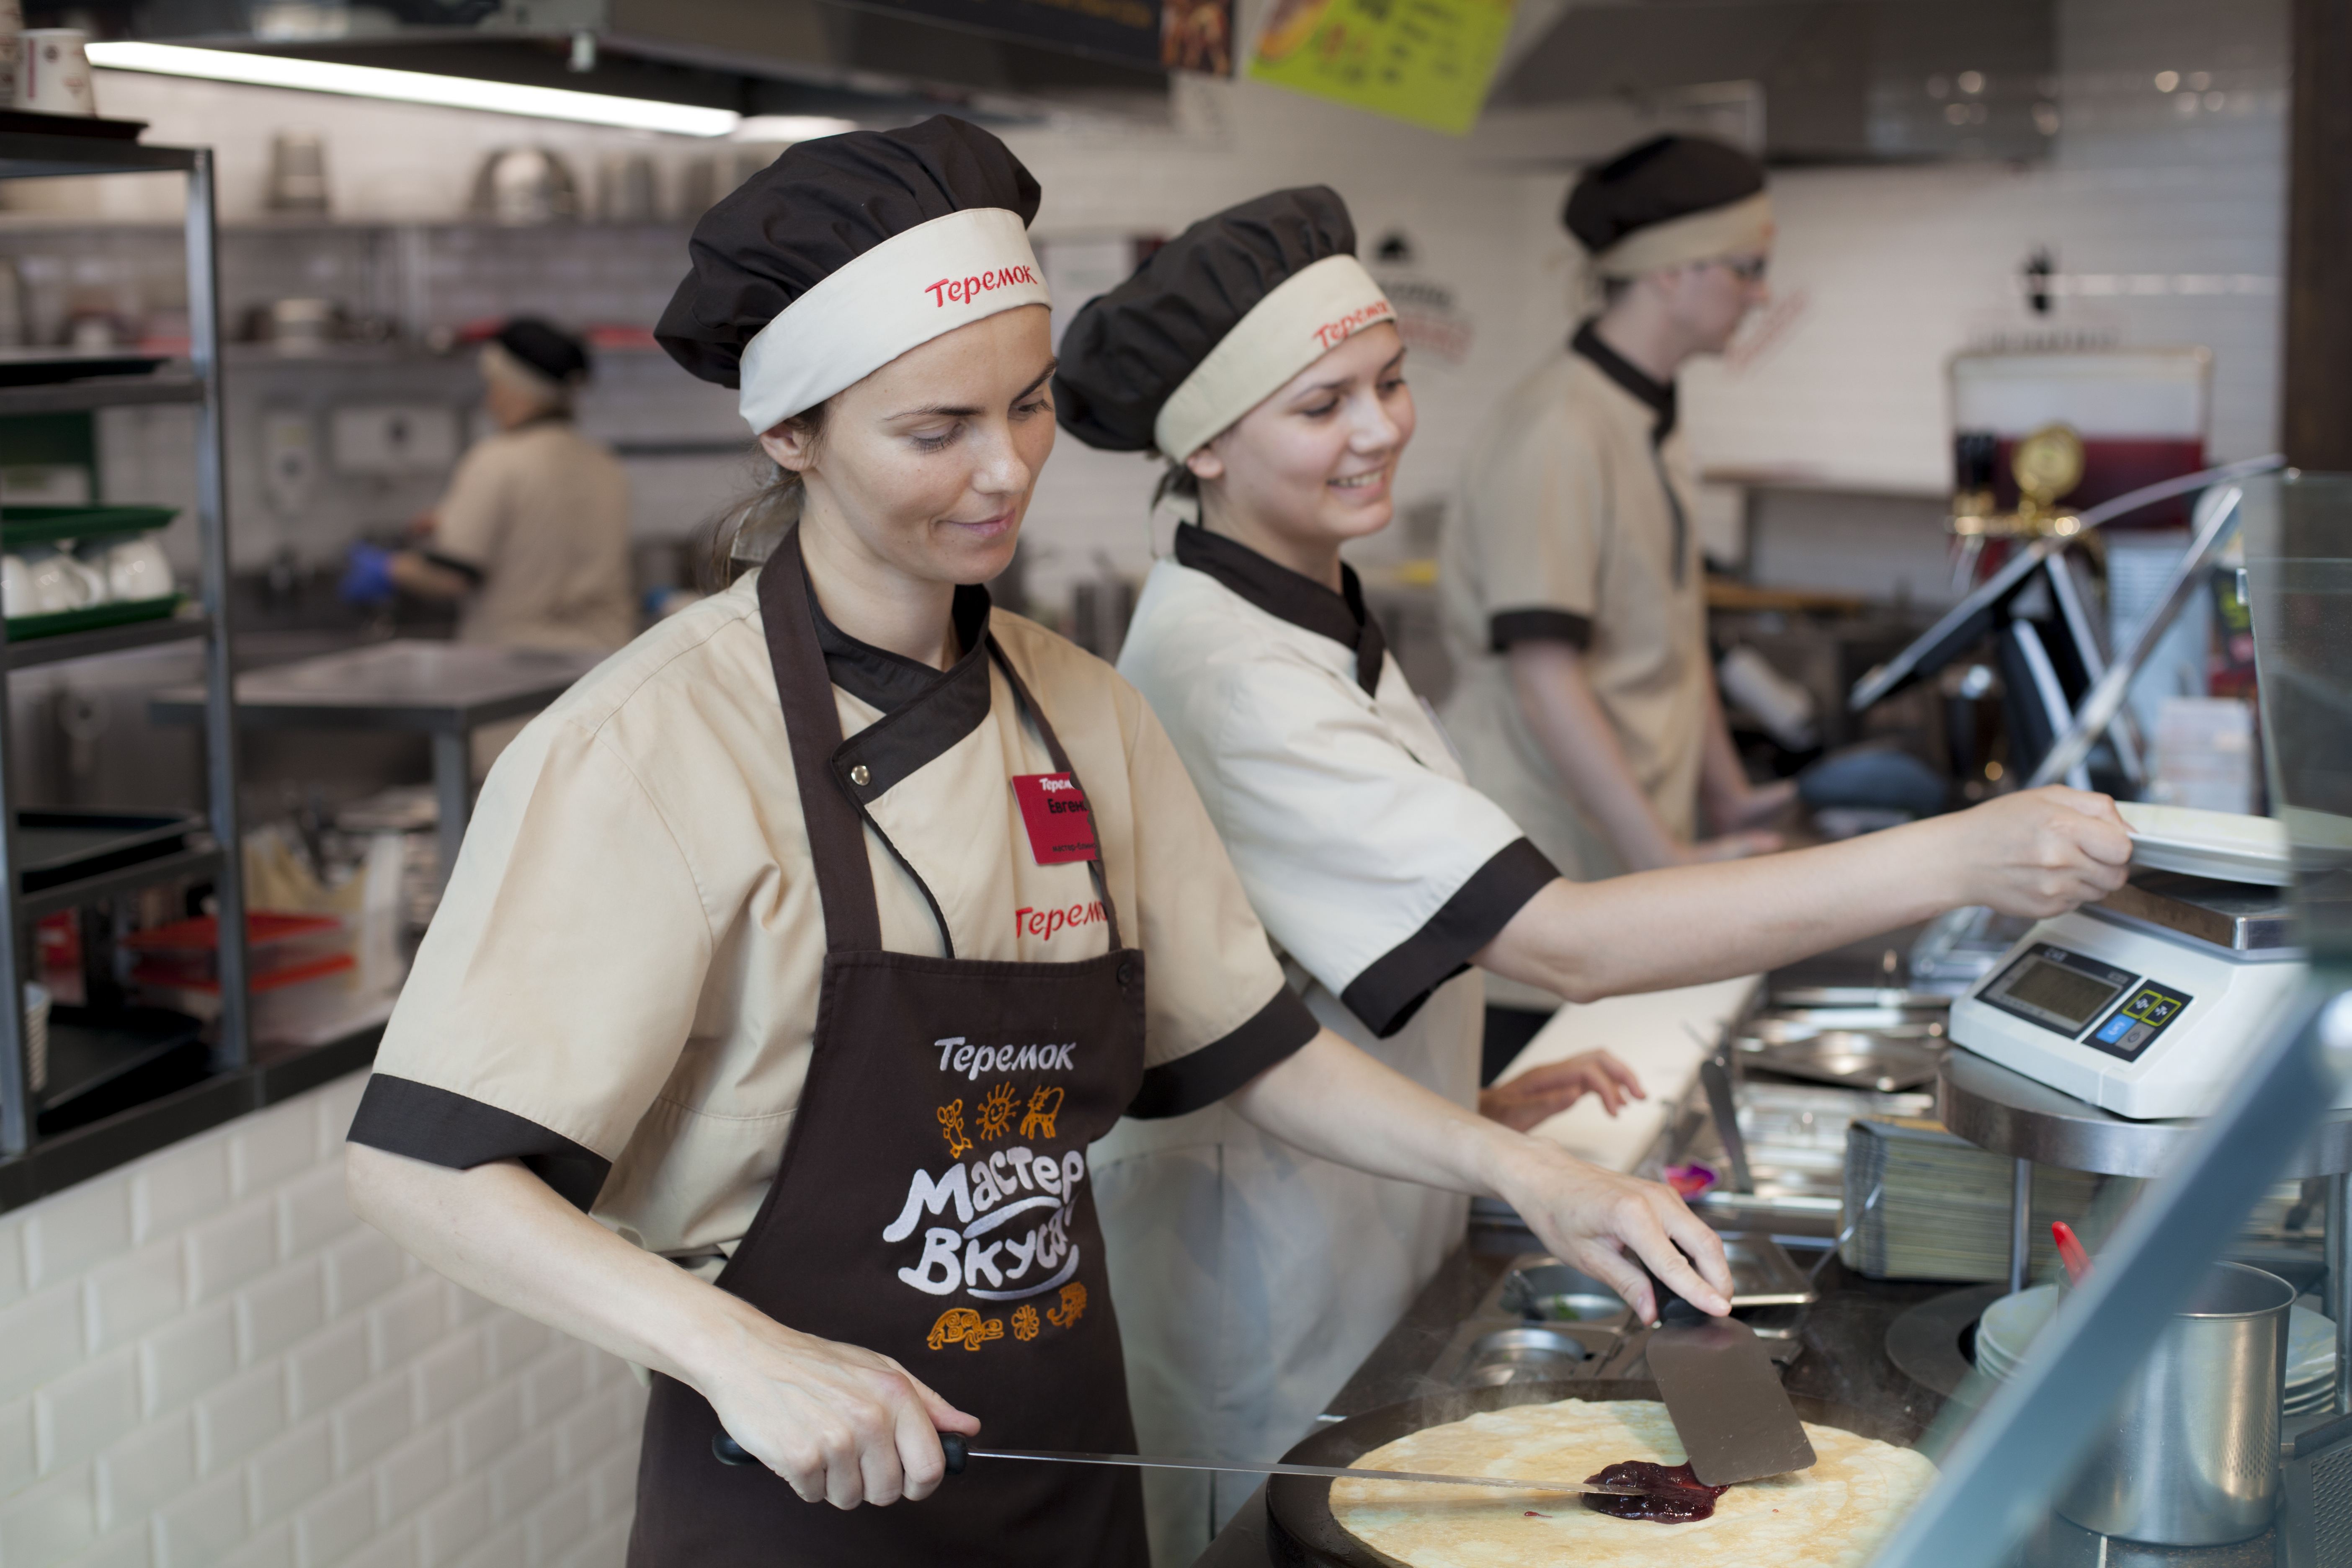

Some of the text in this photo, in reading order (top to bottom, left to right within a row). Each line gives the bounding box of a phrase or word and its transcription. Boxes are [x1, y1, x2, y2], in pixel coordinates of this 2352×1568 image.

[924, 265, 1038, 307] Теремок
[1039, 777, 1075, 793] Терем
[934, 1036, 1076, 1081] Теремок
[882, 1146, 1085, 1243] Мастер
